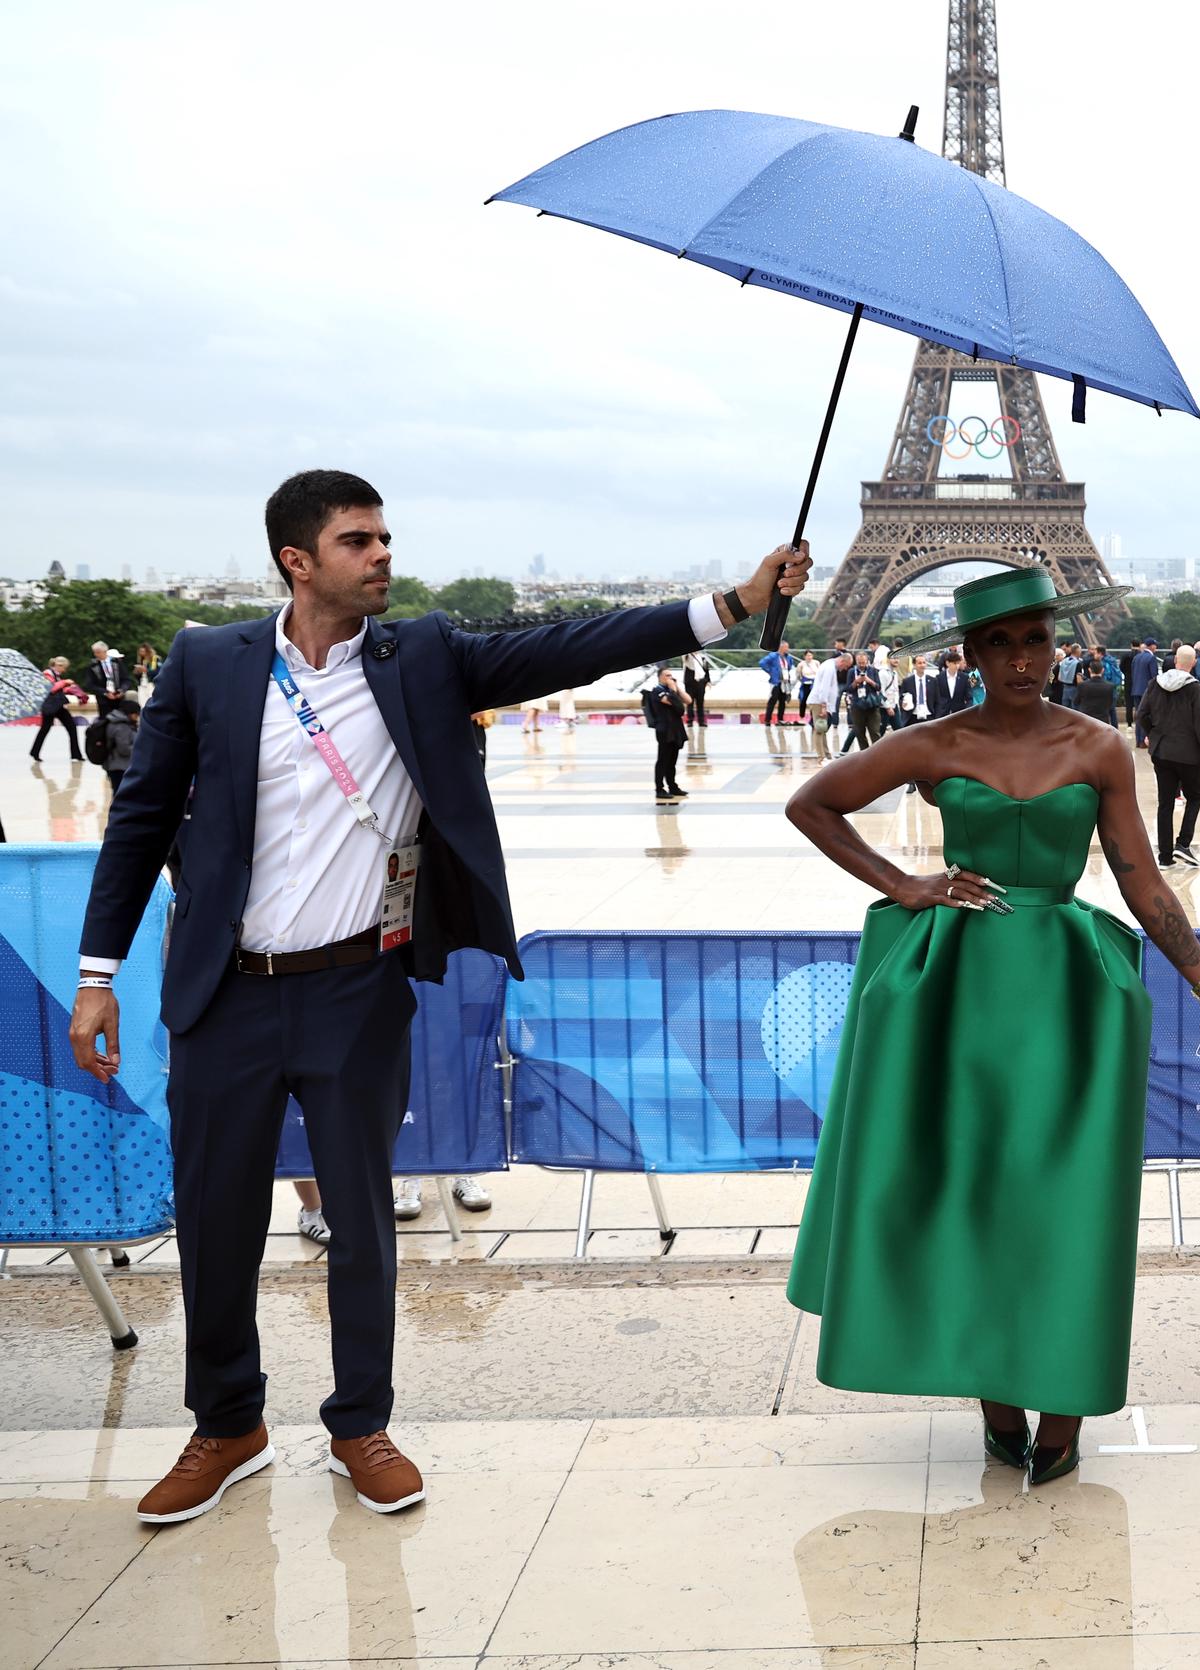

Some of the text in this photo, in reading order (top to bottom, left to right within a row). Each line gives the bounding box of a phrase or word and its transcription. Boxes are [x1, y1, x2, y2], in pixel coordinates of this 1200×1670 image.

[760, 273, 810, 293] OLYMPIC
[816, 289, 904, 322] BROADASTING
[318, 736, 354, 792] PARIS 2024
